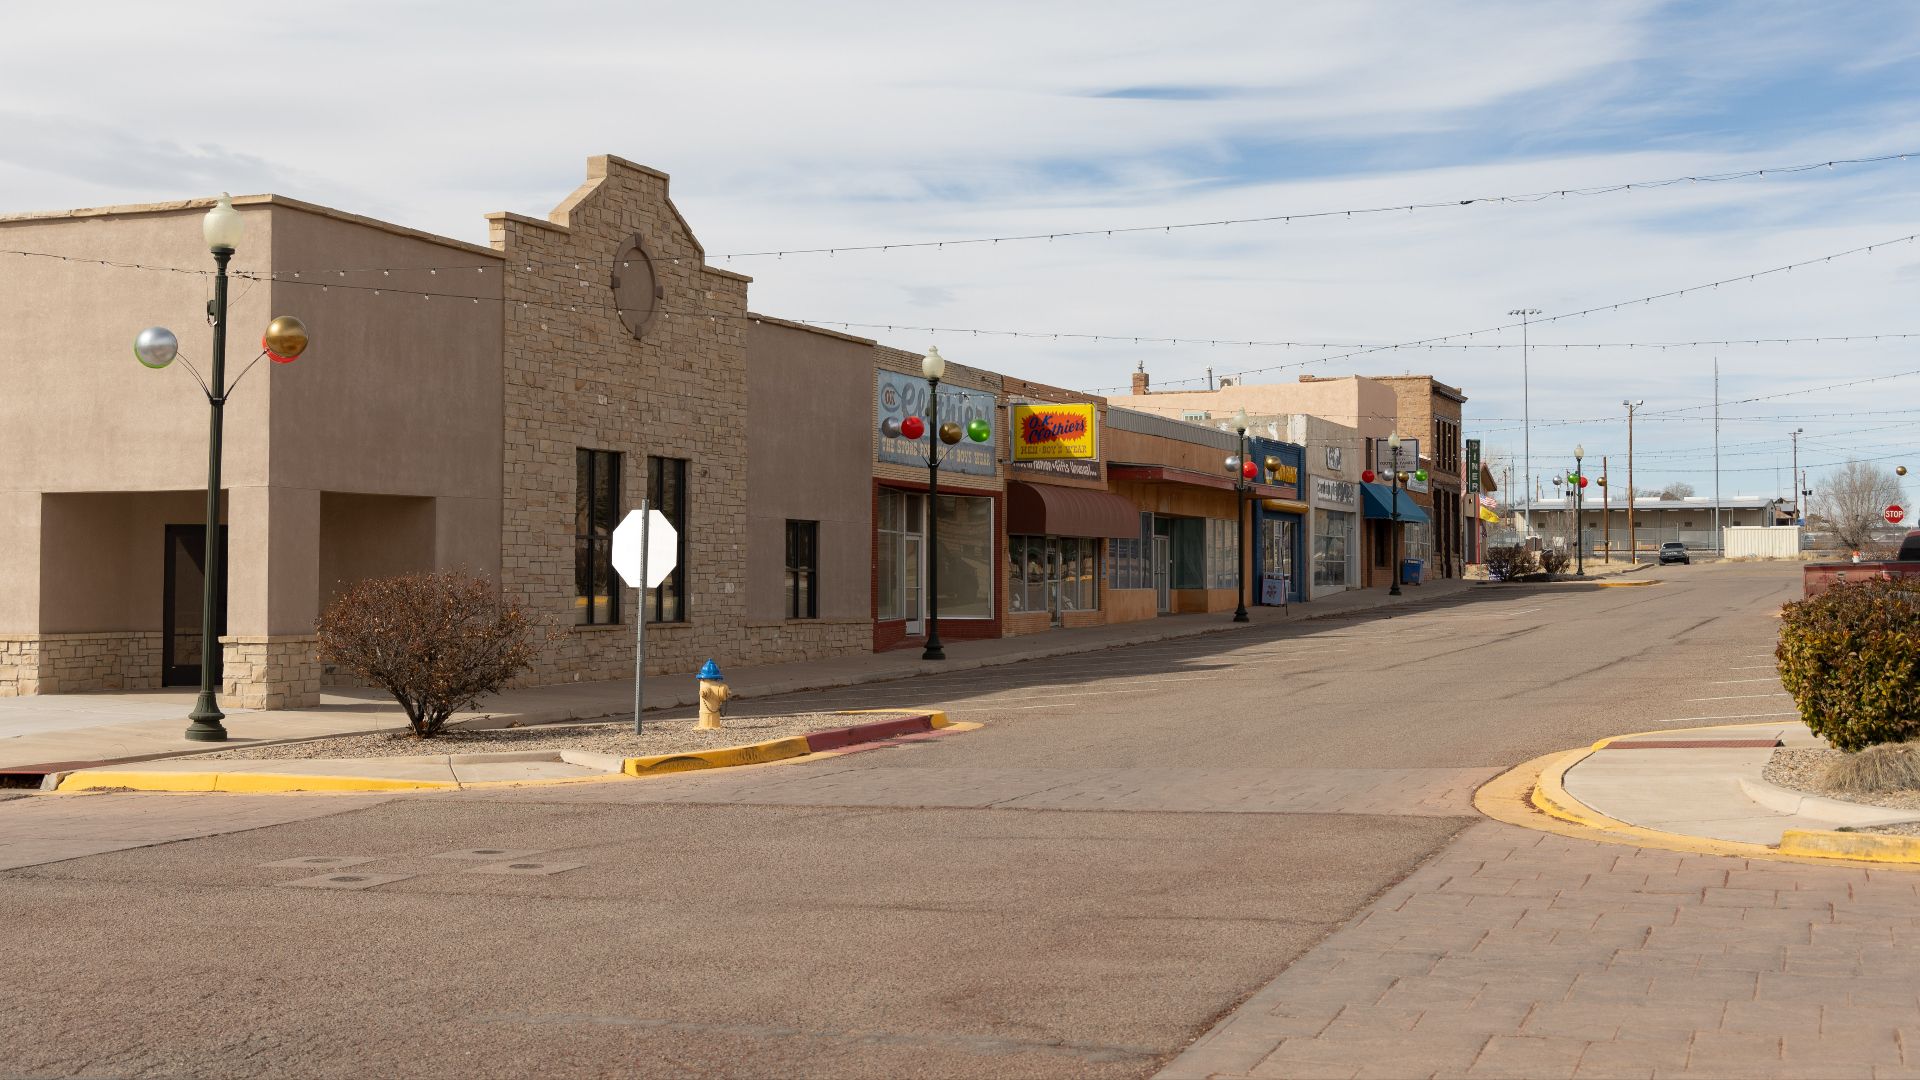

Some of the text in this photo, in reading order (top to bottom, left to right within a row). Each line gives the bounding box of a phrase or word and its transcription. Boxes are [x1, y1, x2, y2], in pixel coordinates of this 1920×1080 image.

[885, 390, 896, 406] OK
[901, 382, 992, 428] Clthiers
[1028, 420, 1085, 443] Clothiers
[1029, 415, 1053, 429] O.K.
[882, 437, 895, 453] THE
[897, 440, 918, 456] STORE
[1471, 442, 1479, 492] DINER
[1885, 510, 1903, 518] STOP
